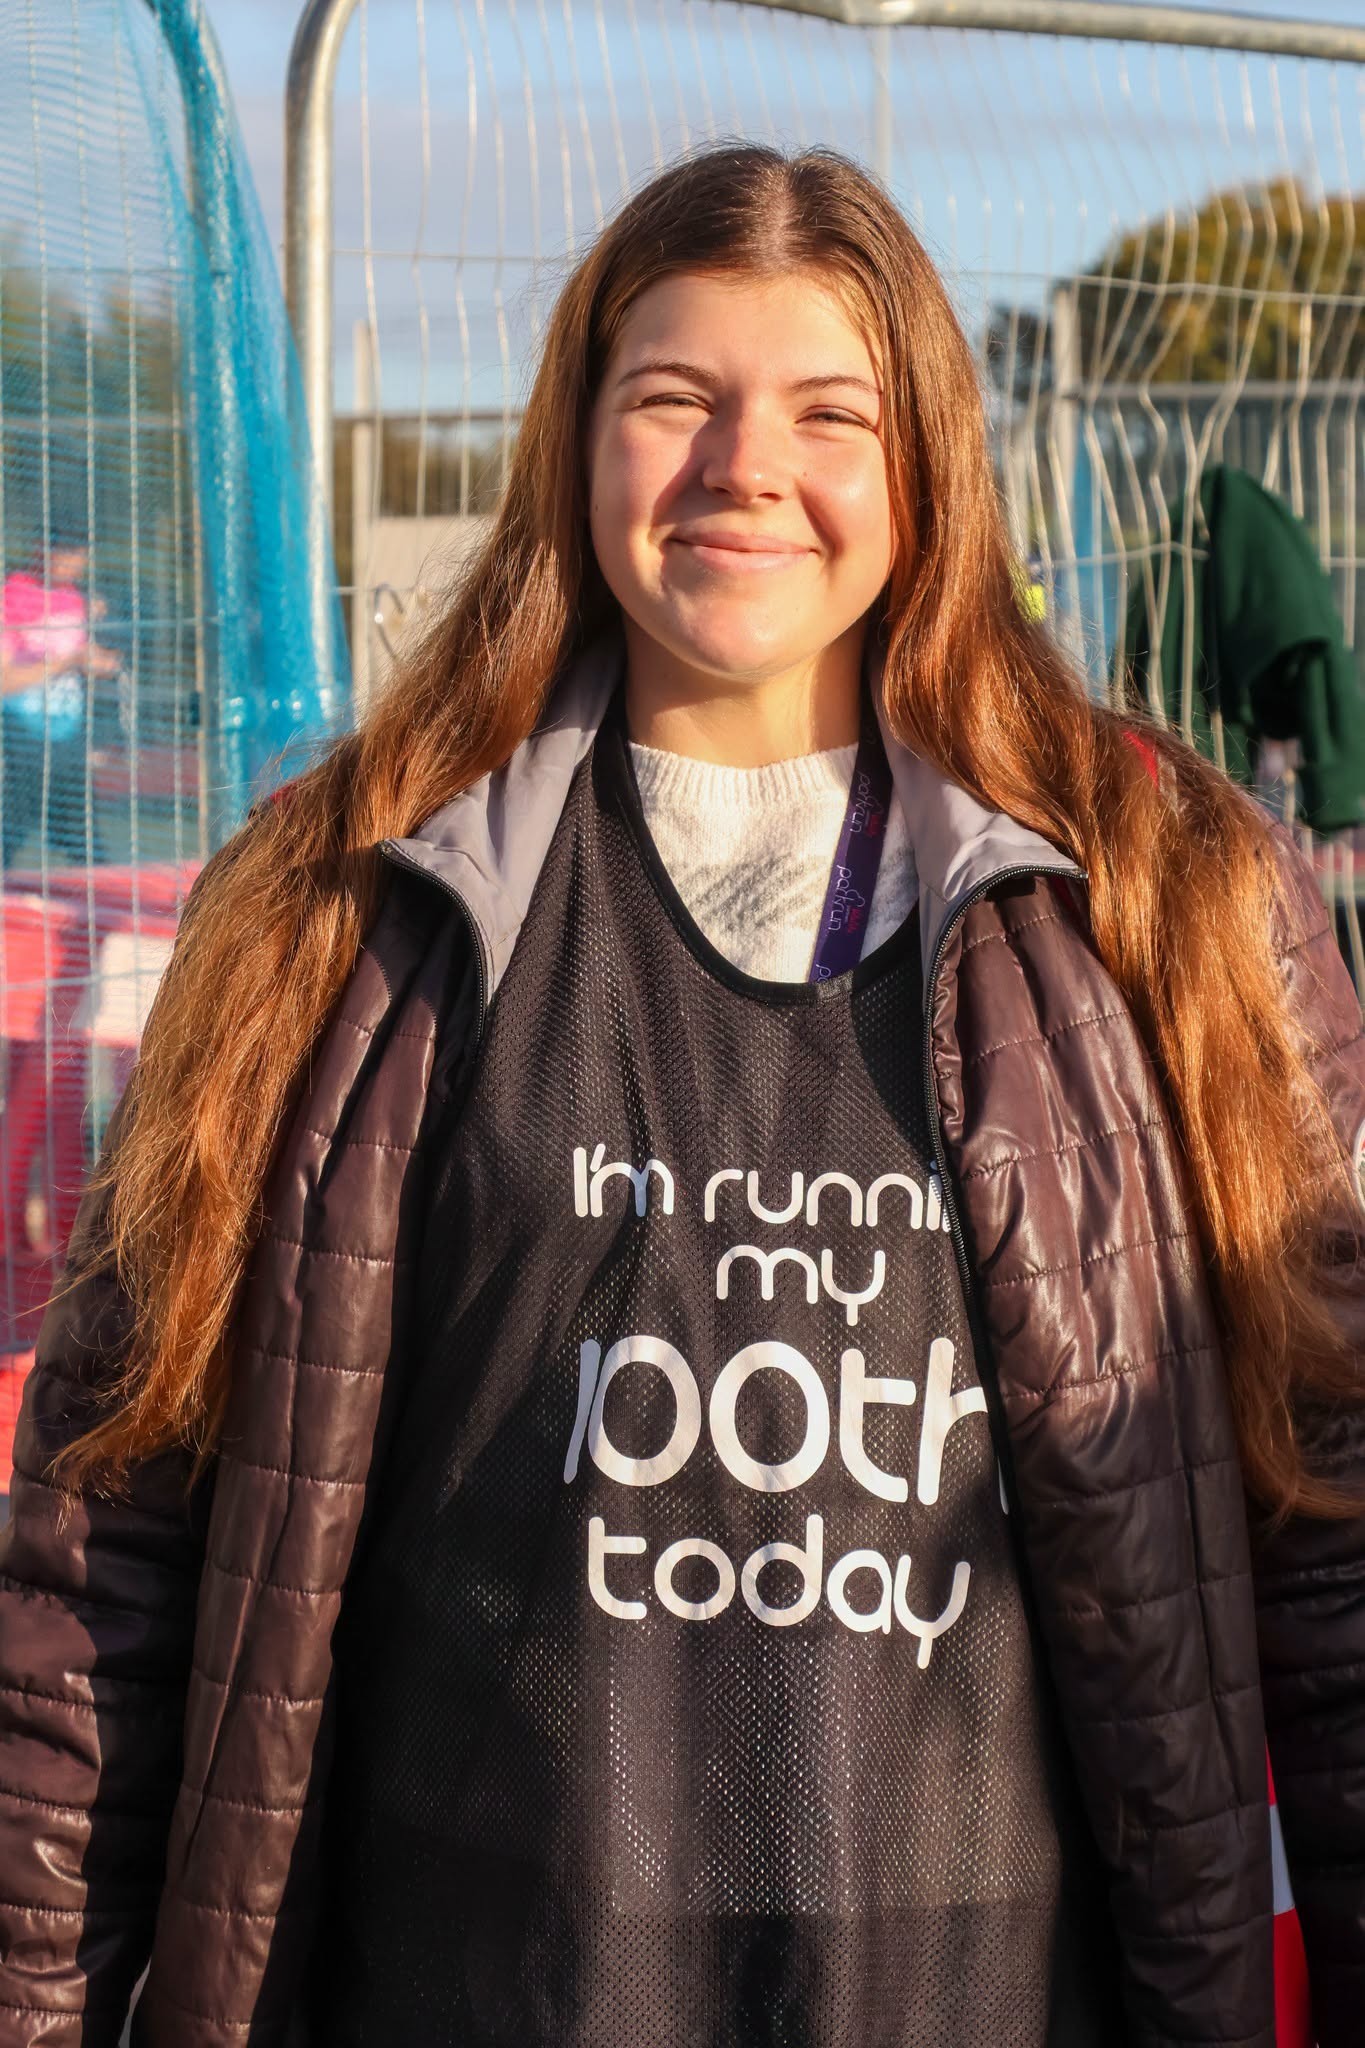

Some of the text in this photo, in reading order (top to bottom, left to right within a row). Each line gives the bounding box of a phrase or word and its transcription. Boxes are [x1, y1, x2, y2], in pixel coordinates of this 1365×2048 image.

[849, 768, 874, 833] parkrun
[828, 864, 856, 931] parkrun
[573, 1141, 675, 1218] I'm
[716, 1244, 887, 1327] my
[564, 1334, 1008, 1515] 100th
[588, 1511, 971, 1670] today
